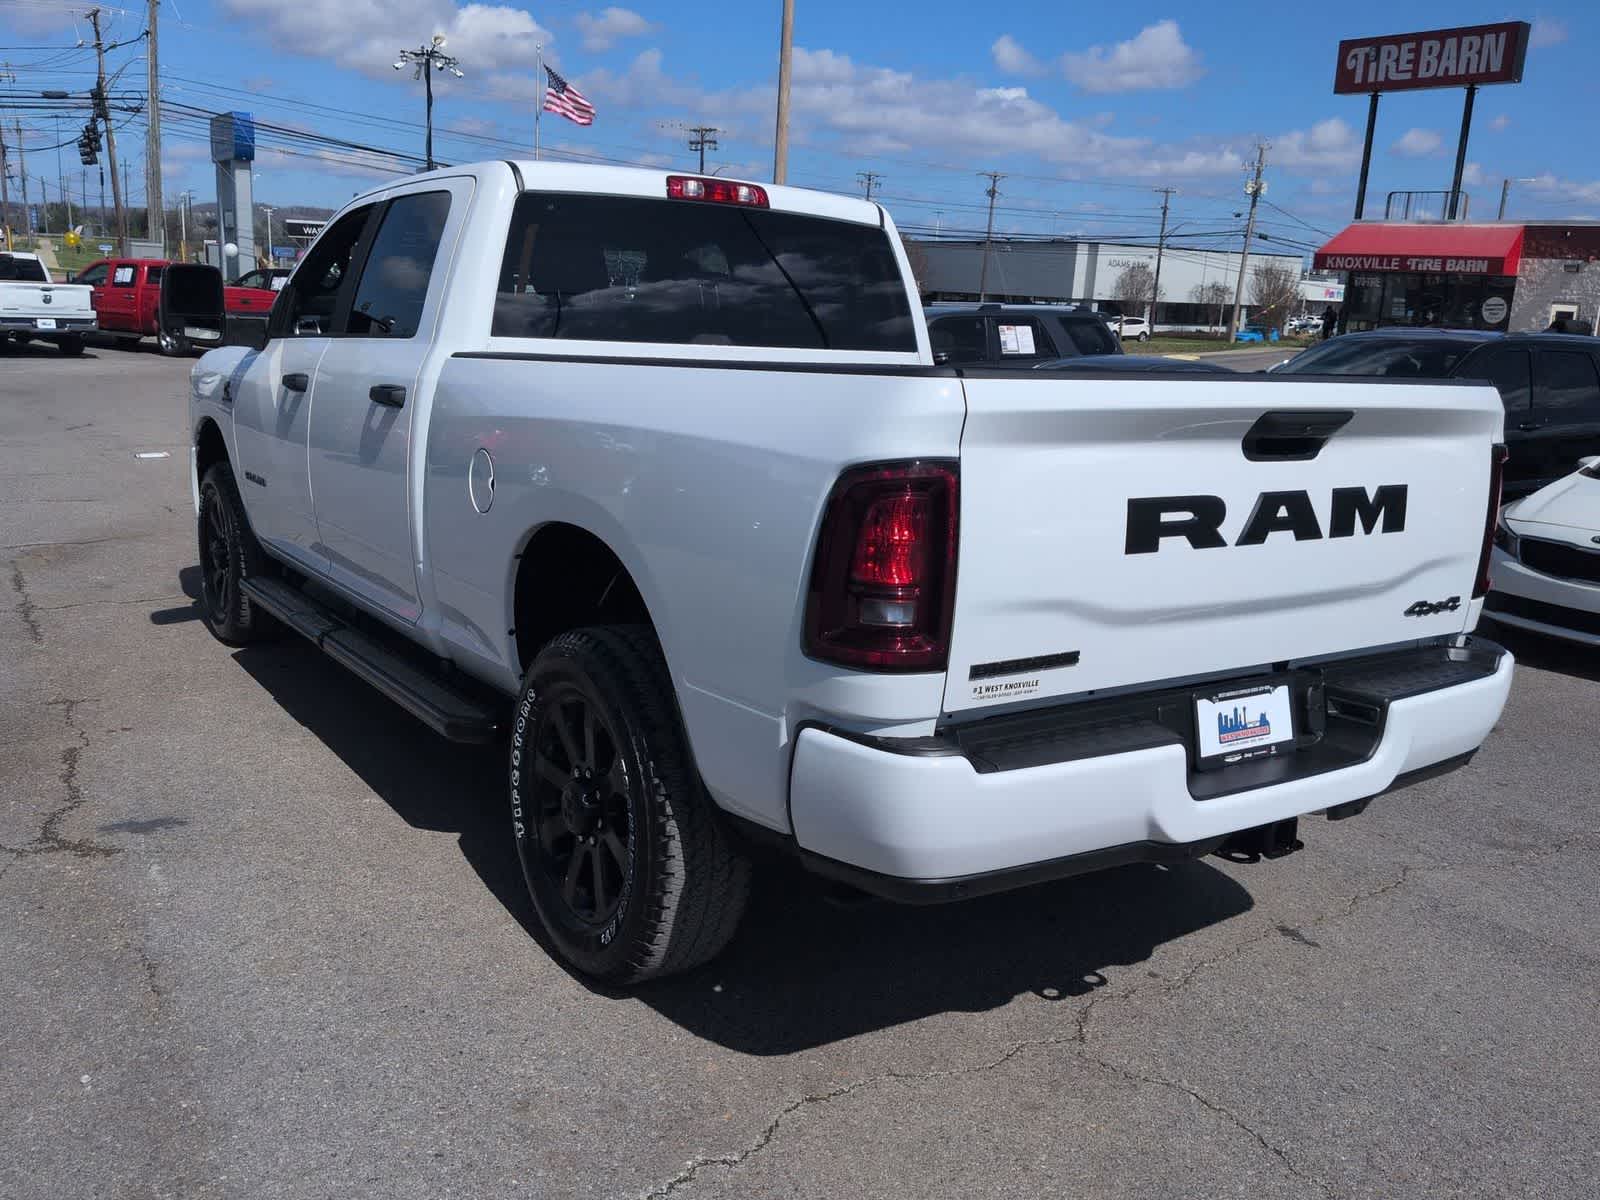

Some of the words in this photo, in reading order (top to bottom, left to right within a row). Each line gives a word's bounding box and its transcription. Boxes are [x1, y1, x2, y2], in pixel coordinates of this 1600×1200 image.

[1417, 32, 1507, 79] BARN
[1326, 256, 1400, 270] KNOXVILLE
[1445, 259, 1488, 273] BARN
[1125, 484, 1408, 555] RAM
[985, 683, 1003, 693] WEST
[1004, 679, 1040, 690] KNOXVILLE
